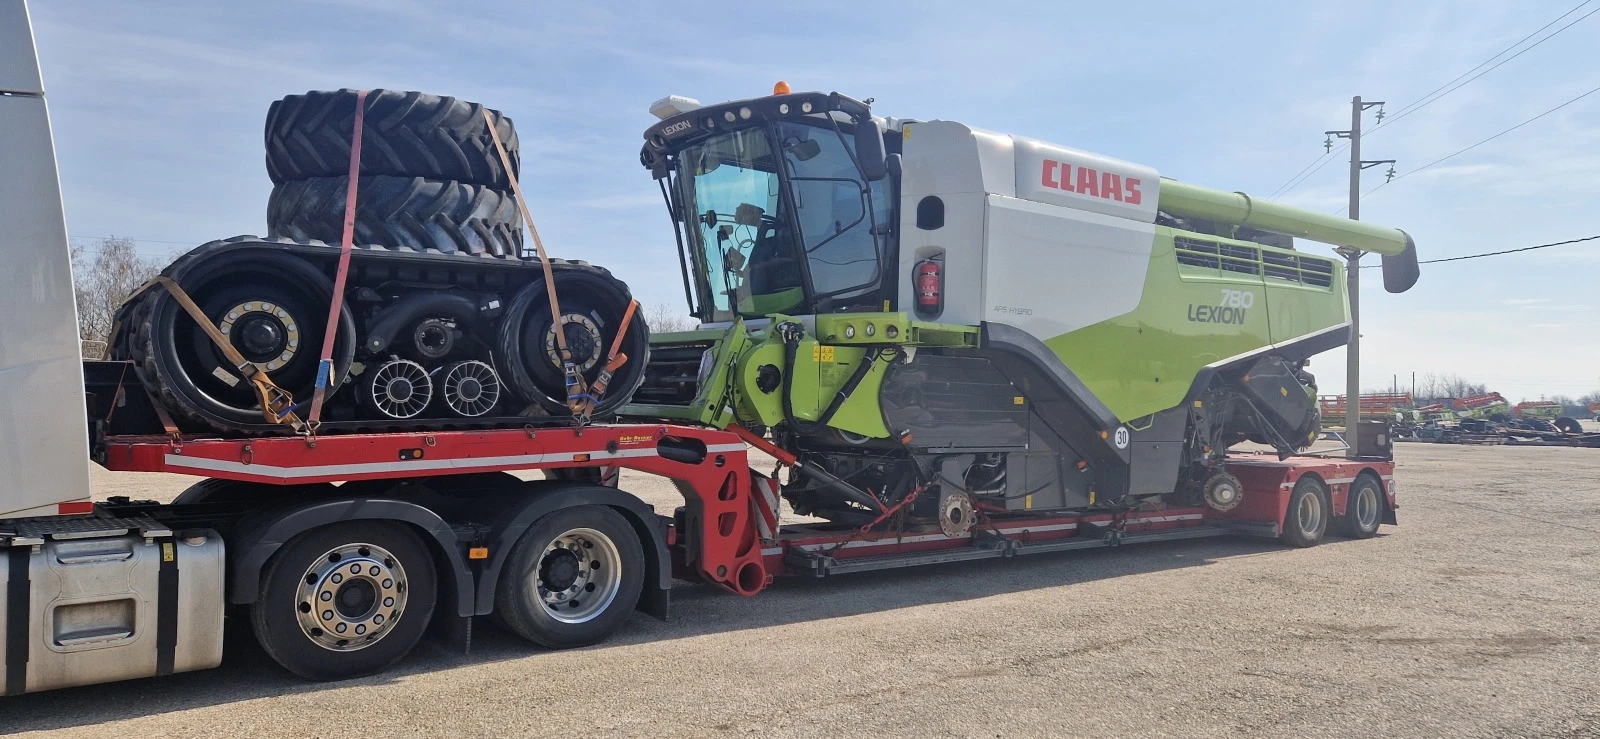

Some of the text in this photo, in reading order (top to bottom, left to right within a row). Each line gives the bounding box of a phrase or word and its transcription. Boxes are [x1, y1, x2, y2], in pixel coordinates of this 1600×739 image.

[662, 120, 691, 135] LEXION
[1042, 159, 1142, 205] CLAAS
[1219, 288, 1254, 308] 780
[993, 305, 1007, 313] APS
[1187, 303, 1246, 325] LEXION
[1117, 431, 1126, 445] 30
